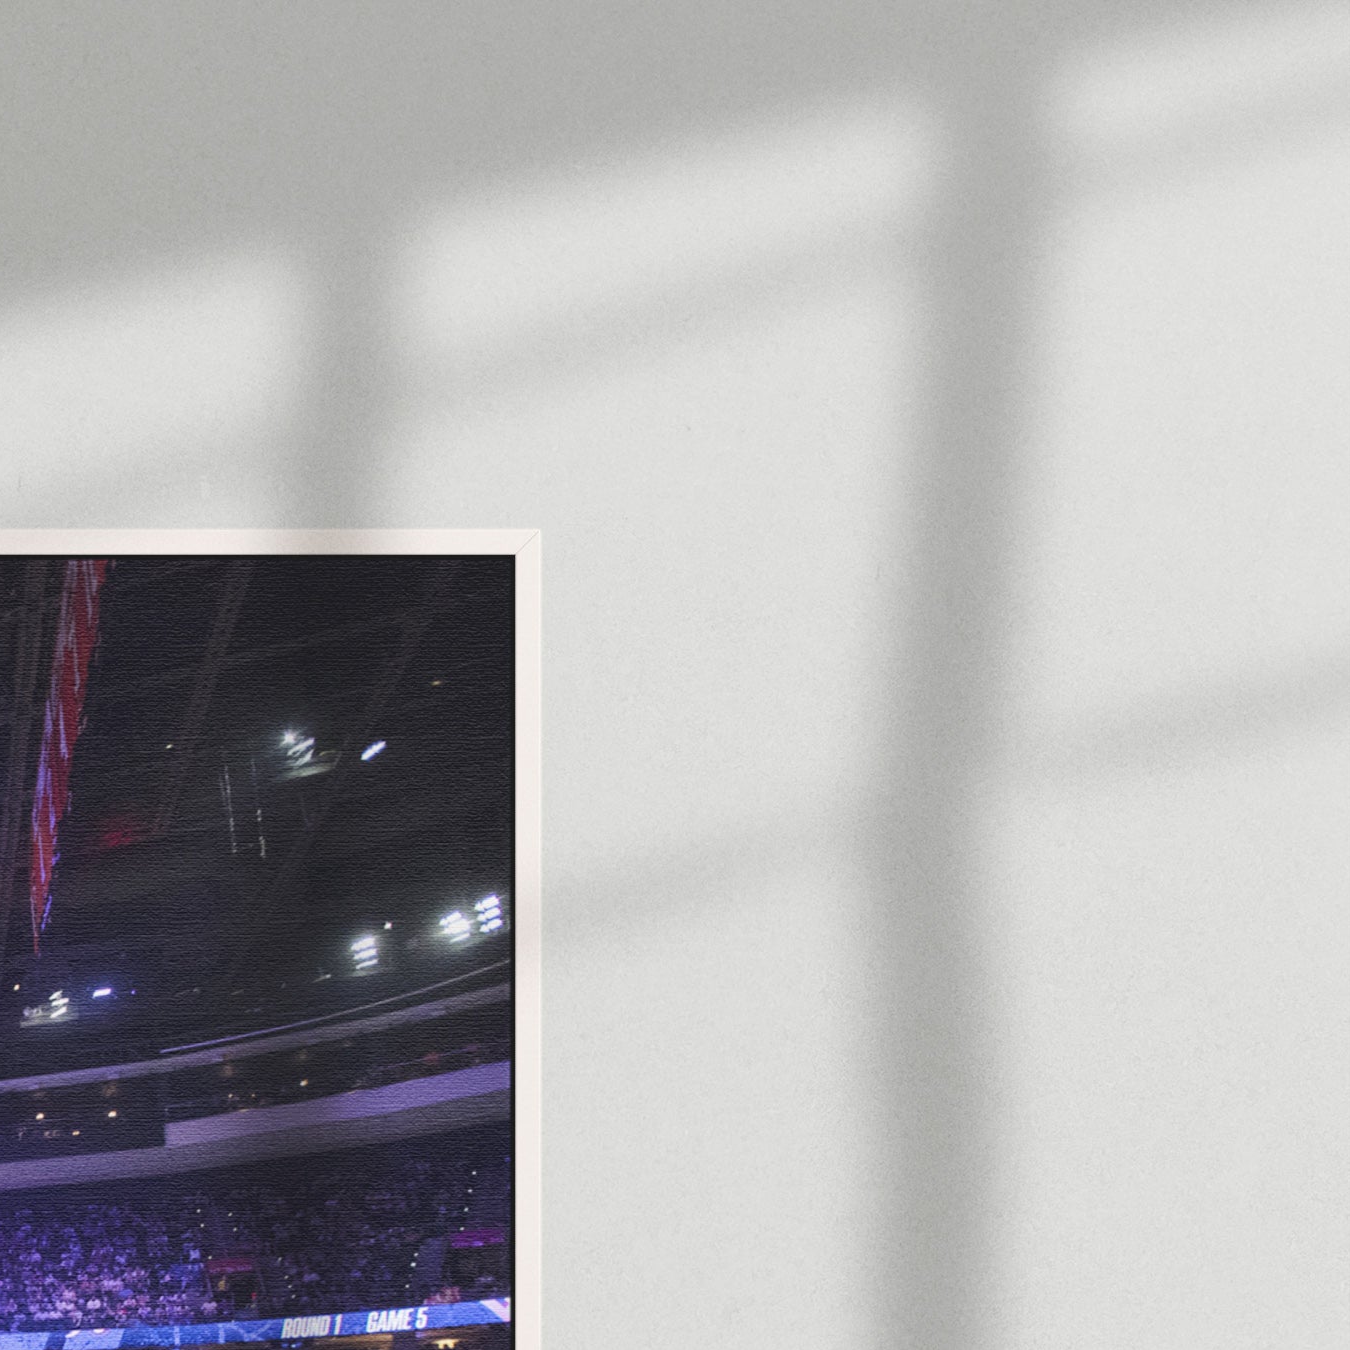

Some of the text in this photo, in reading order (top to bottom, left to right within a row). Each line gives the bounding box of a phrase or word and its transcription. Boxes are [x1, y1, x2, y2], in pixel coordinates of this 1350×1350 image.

[281, 1306, 428, 1339] ROUND 1 GAME 5
